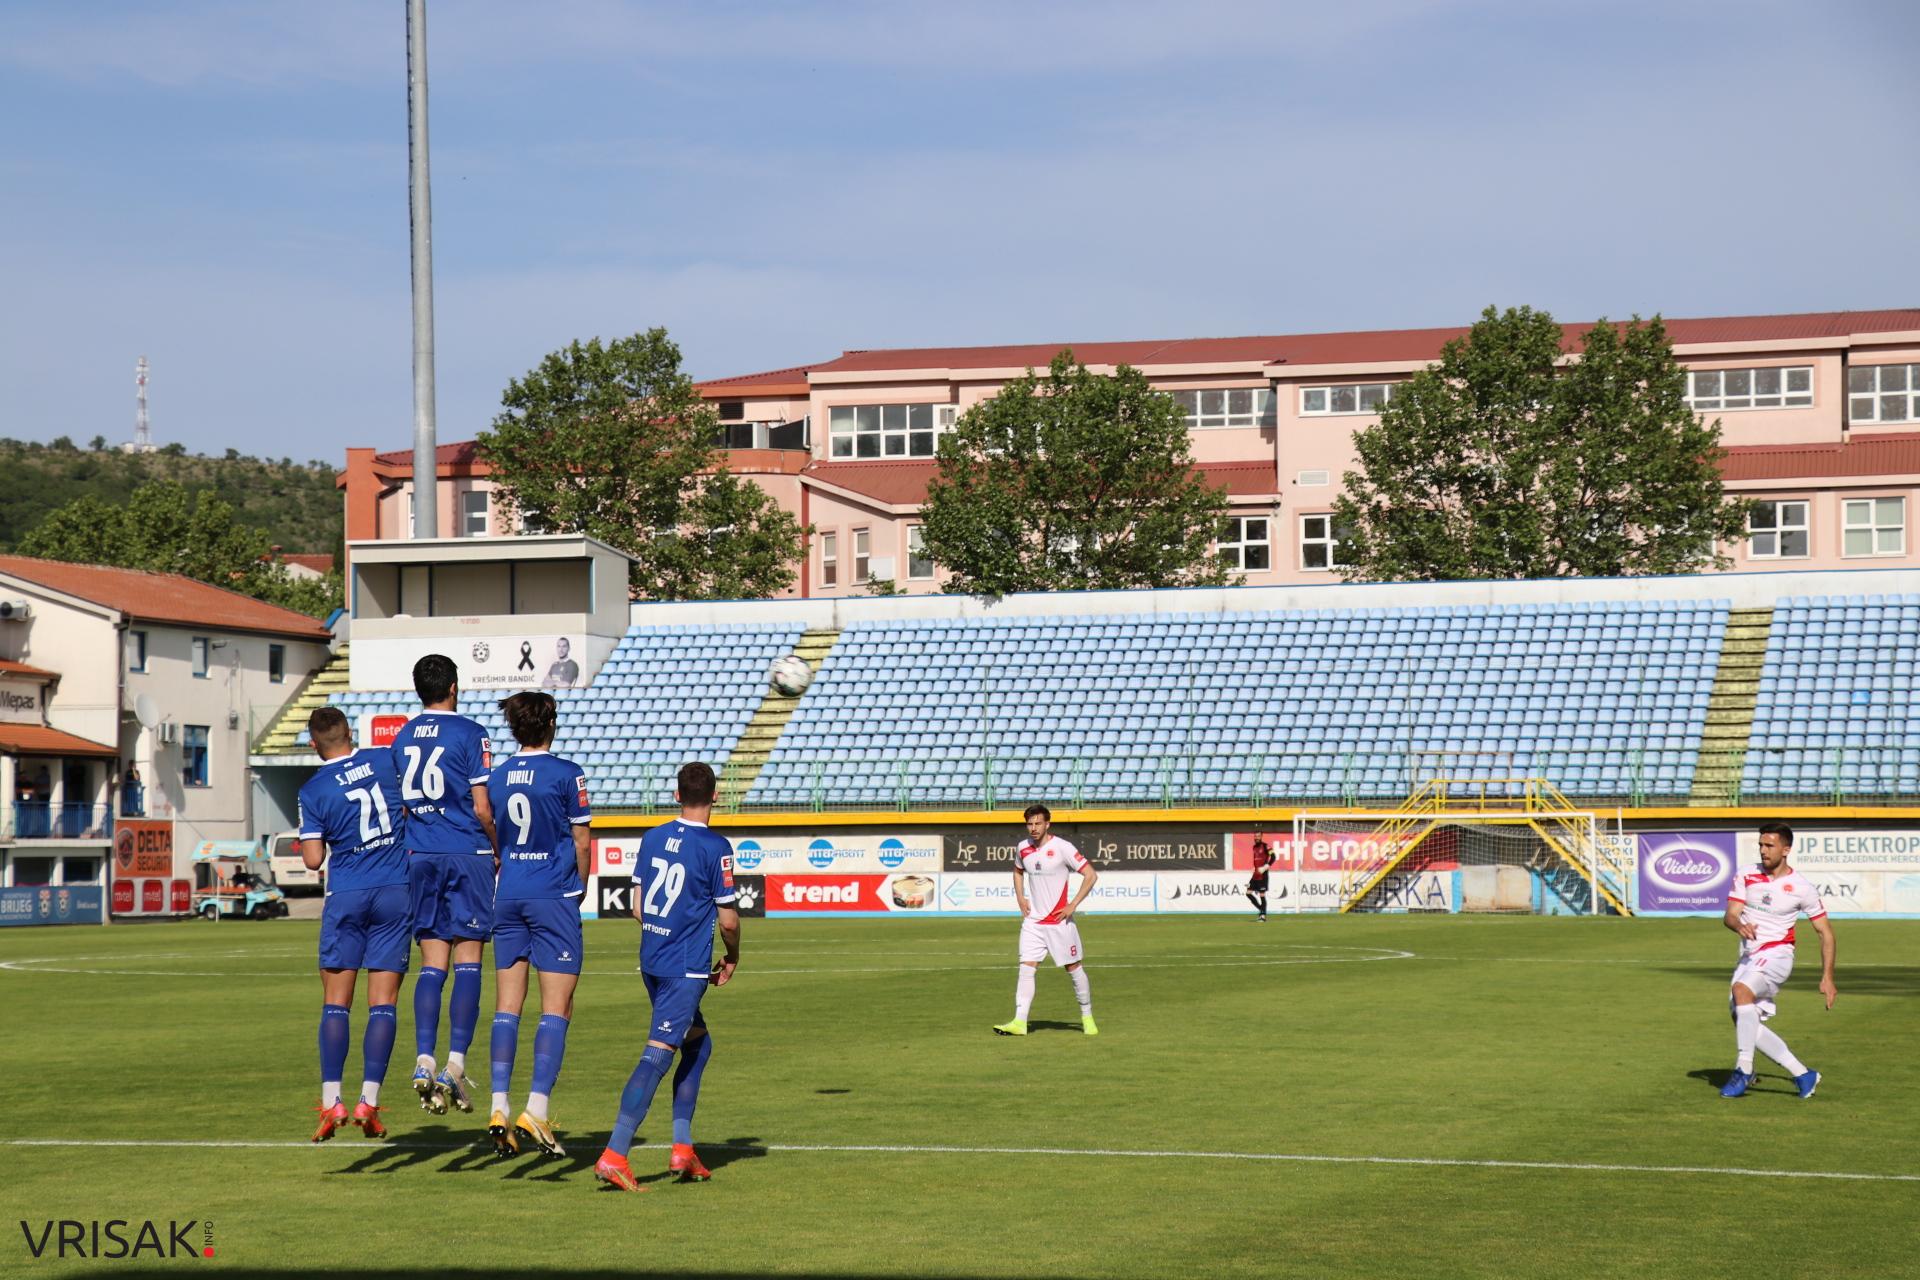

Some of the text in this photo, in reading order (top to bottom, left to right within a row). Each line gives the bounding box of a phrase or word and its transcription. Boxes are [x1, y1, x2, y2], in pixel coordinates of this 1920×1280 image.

[472, 673, 536, 684] KREŠIMIR BANDIĆ
[413, 724, 439, 738] MUSA
[401, 745, 445, 800] 26
[344, 781, 392, 843] 21
[507, 792, 531, 845] 9
[137, 830, 172, 854] DELTA
[1797, 836, 1920, 854] JP ELEKTROP
[1126, 844, 1176, 860] HOTEL
[1178, 843, 1217, 859] PARK
[1797, 855, 1840, 864] HRVATSKE
[1842, 855, 1888, 864] ZAJEDNICE
[137, 855, 172, 873] SECURITY
[1662, 856, 1714, 875] Violeta
[643, 857, 686, 918] 29
[783, 881, 859, 903] trend
[0, 900, 32, 914] BRIJEG
[1070, 945, 1078, 957] 8
